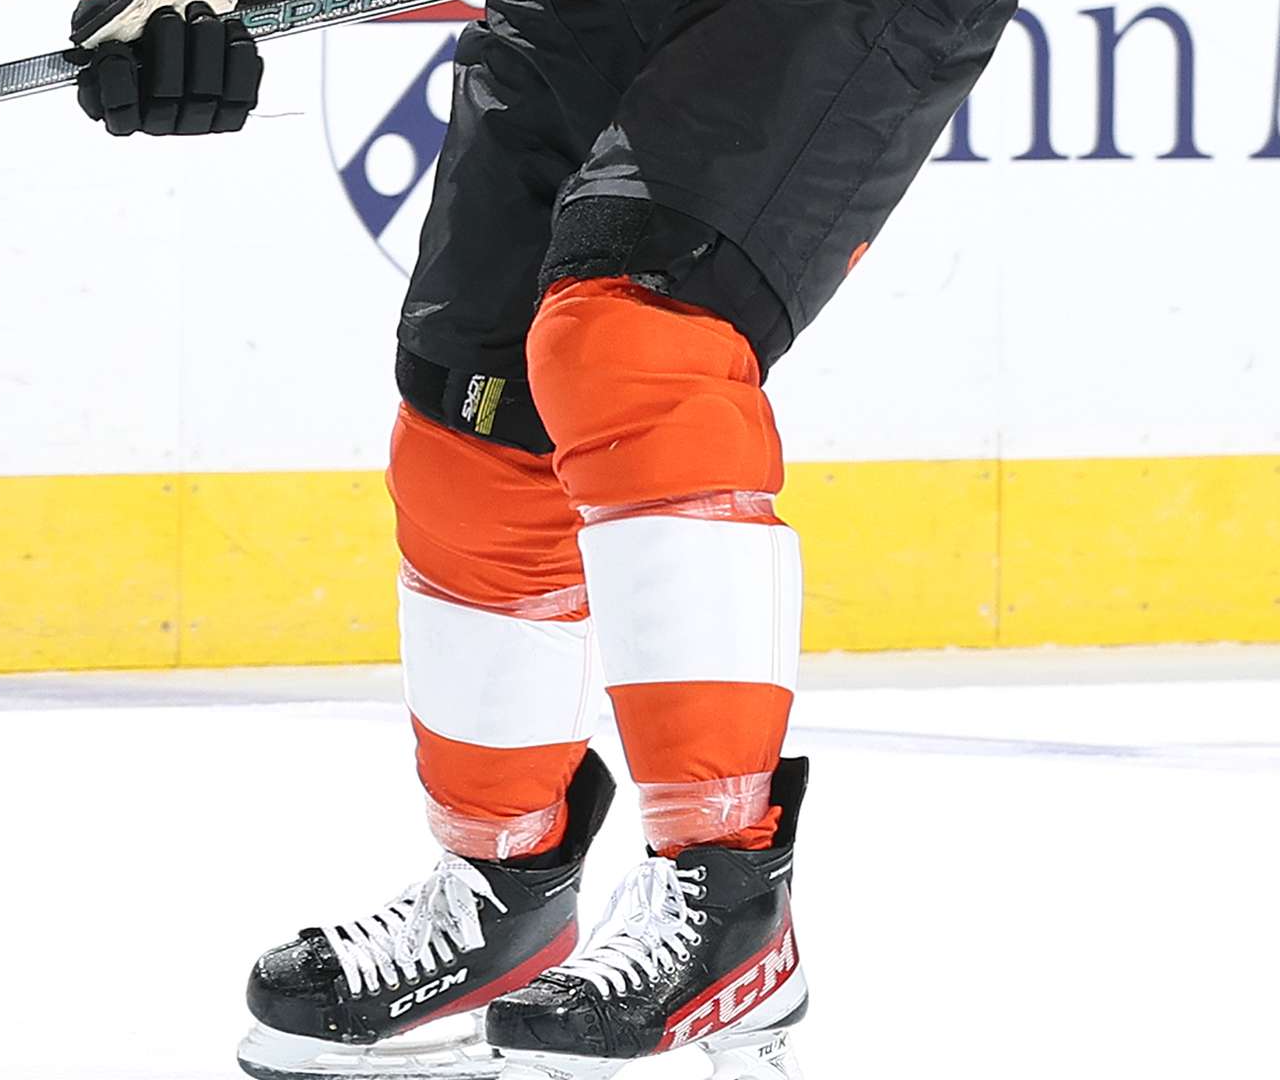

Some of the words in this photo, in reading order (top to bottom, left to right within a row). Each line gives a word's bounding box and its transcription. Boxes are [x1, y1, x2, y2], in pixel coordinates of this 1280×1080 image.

[929, 3, 1215, 163] nn
[389, 967, 468, 1018] CCM
[670, 927, 796, 1049] CCM
